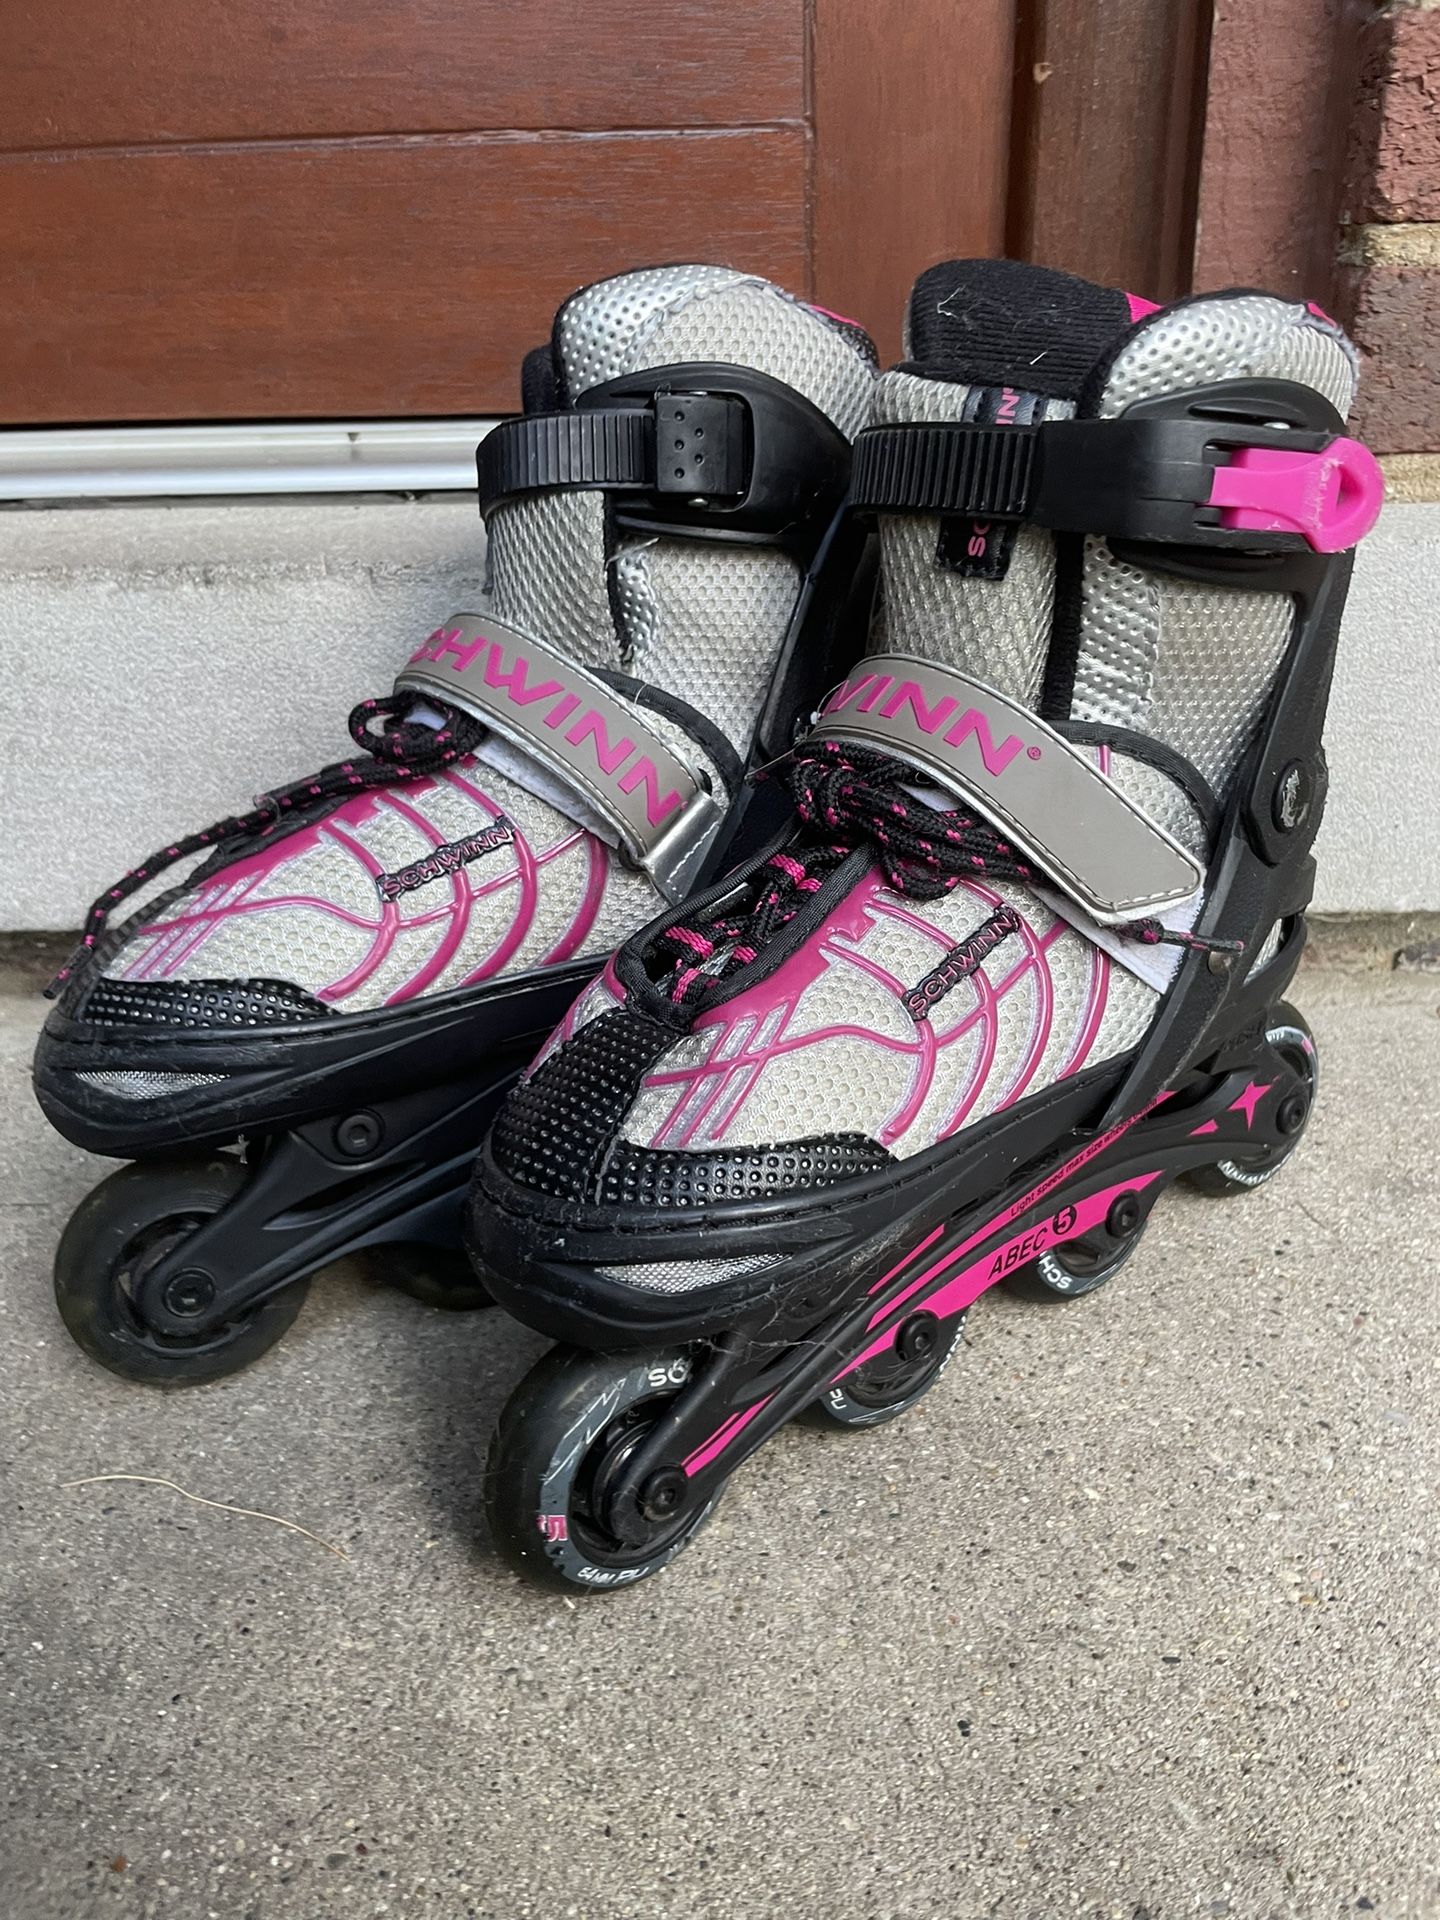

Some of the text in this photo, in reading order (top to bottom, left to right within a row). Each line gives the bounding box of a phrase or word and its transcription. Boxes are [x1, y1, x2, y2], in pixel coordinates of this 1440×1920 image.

[382, 825, 511, 895] SCHWINN
[907, 913, 1014, 1013] SCHWINN
[1011, 1193, 1036, 1216] Light
[1036, 1168, 1065, 1197] speed
[1065, 1155, 1085, 1174] max
[1086, 1139, 1104, 1157] size
[988, 1205, 1076, 1280] ABEC 5
